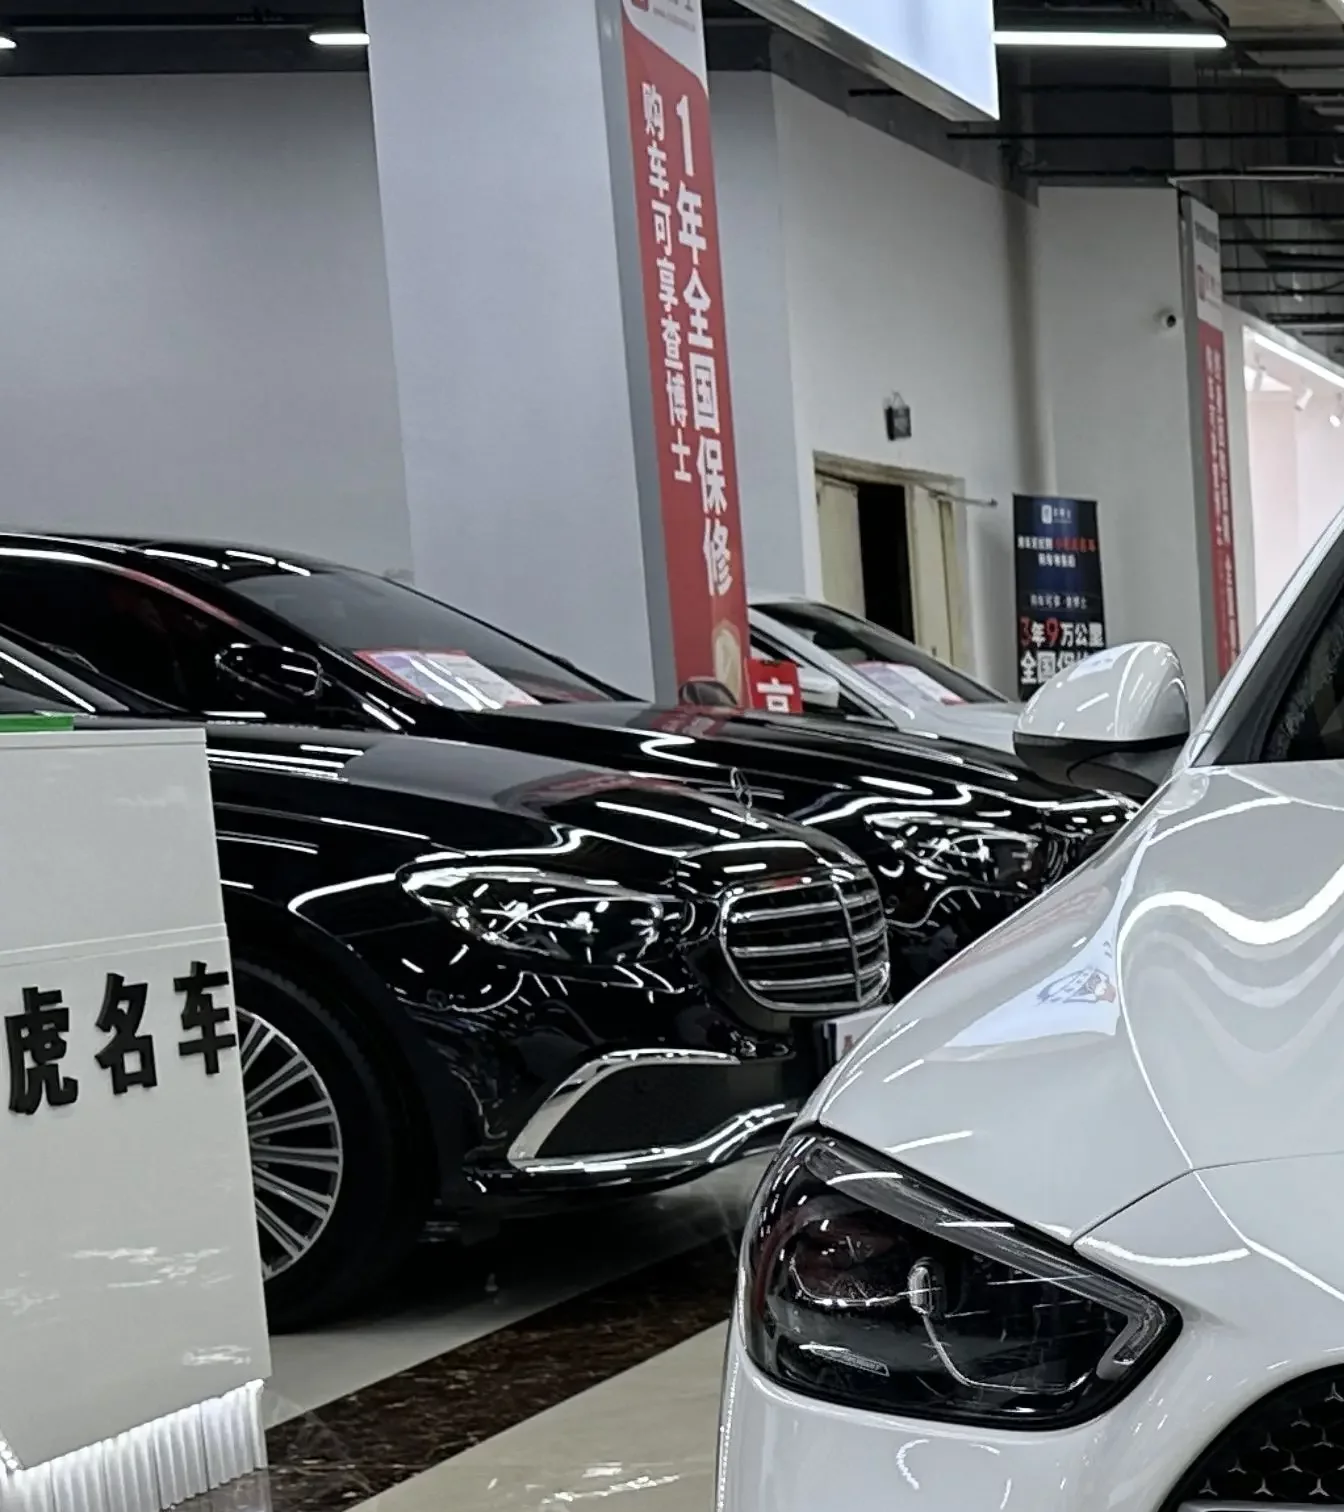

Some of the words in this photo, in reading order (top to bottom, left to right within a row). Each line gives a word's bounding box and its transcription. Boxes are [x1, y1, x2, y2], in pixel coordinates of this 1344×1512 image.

[641, 81, 692, 483] 购车可享查博士
[675, 94, 733, 596] 1年全国保修
[3, 960, 238, 1116] 虎名车
